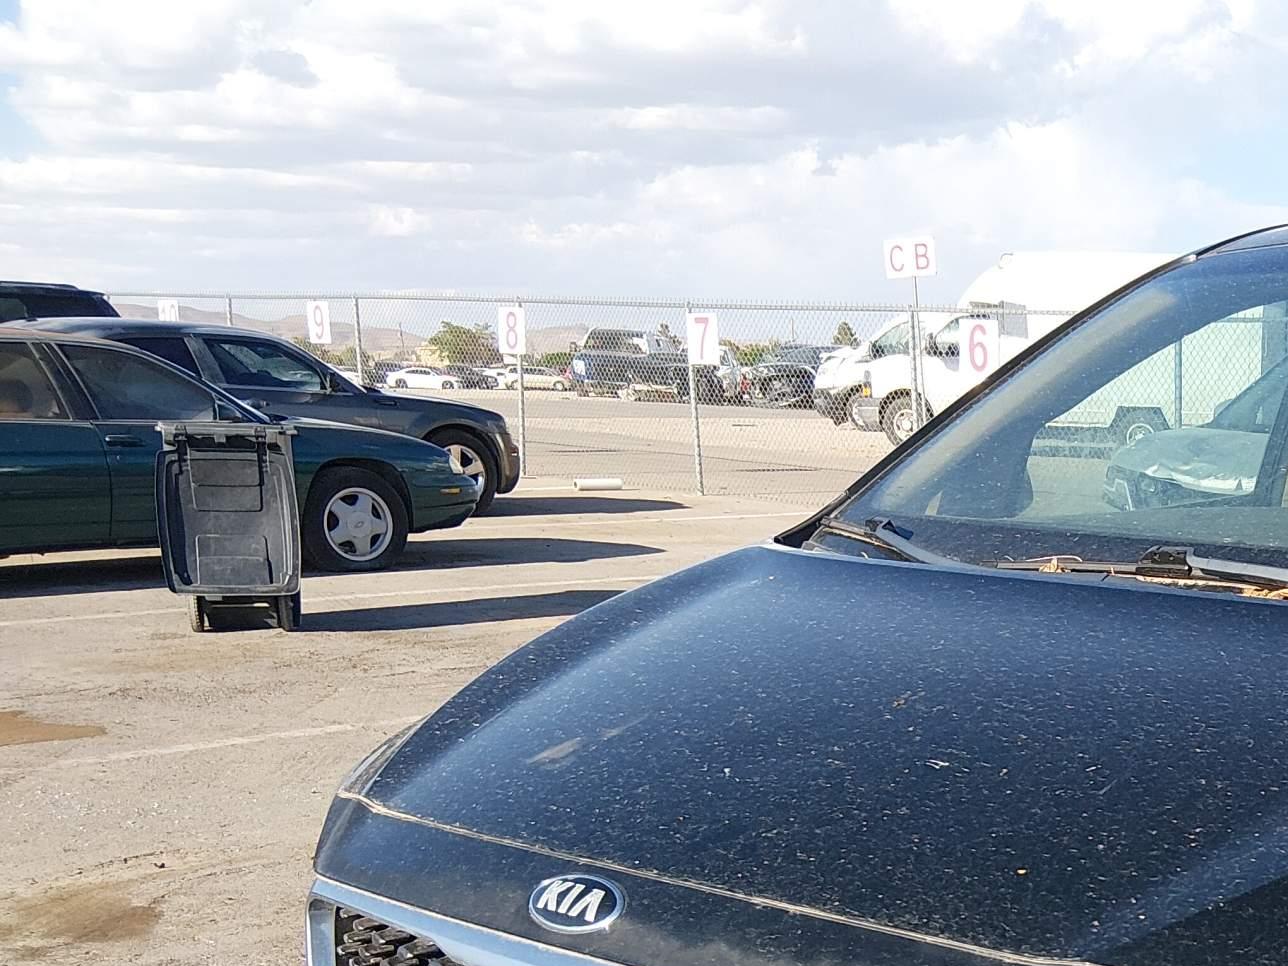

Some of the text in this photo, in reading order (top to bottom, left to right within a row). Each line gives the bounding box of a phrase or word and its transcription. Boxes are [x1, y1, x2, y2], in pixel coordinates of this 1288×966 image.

[889, 243, 930, 272] C B
[313, 305, 325, 340] 9
[506, 311, 518, 350] 8
[694, 317, 709, 361] 7
[969, 324, 989, 373] 6
[536, 880, 606, 922] KIA
